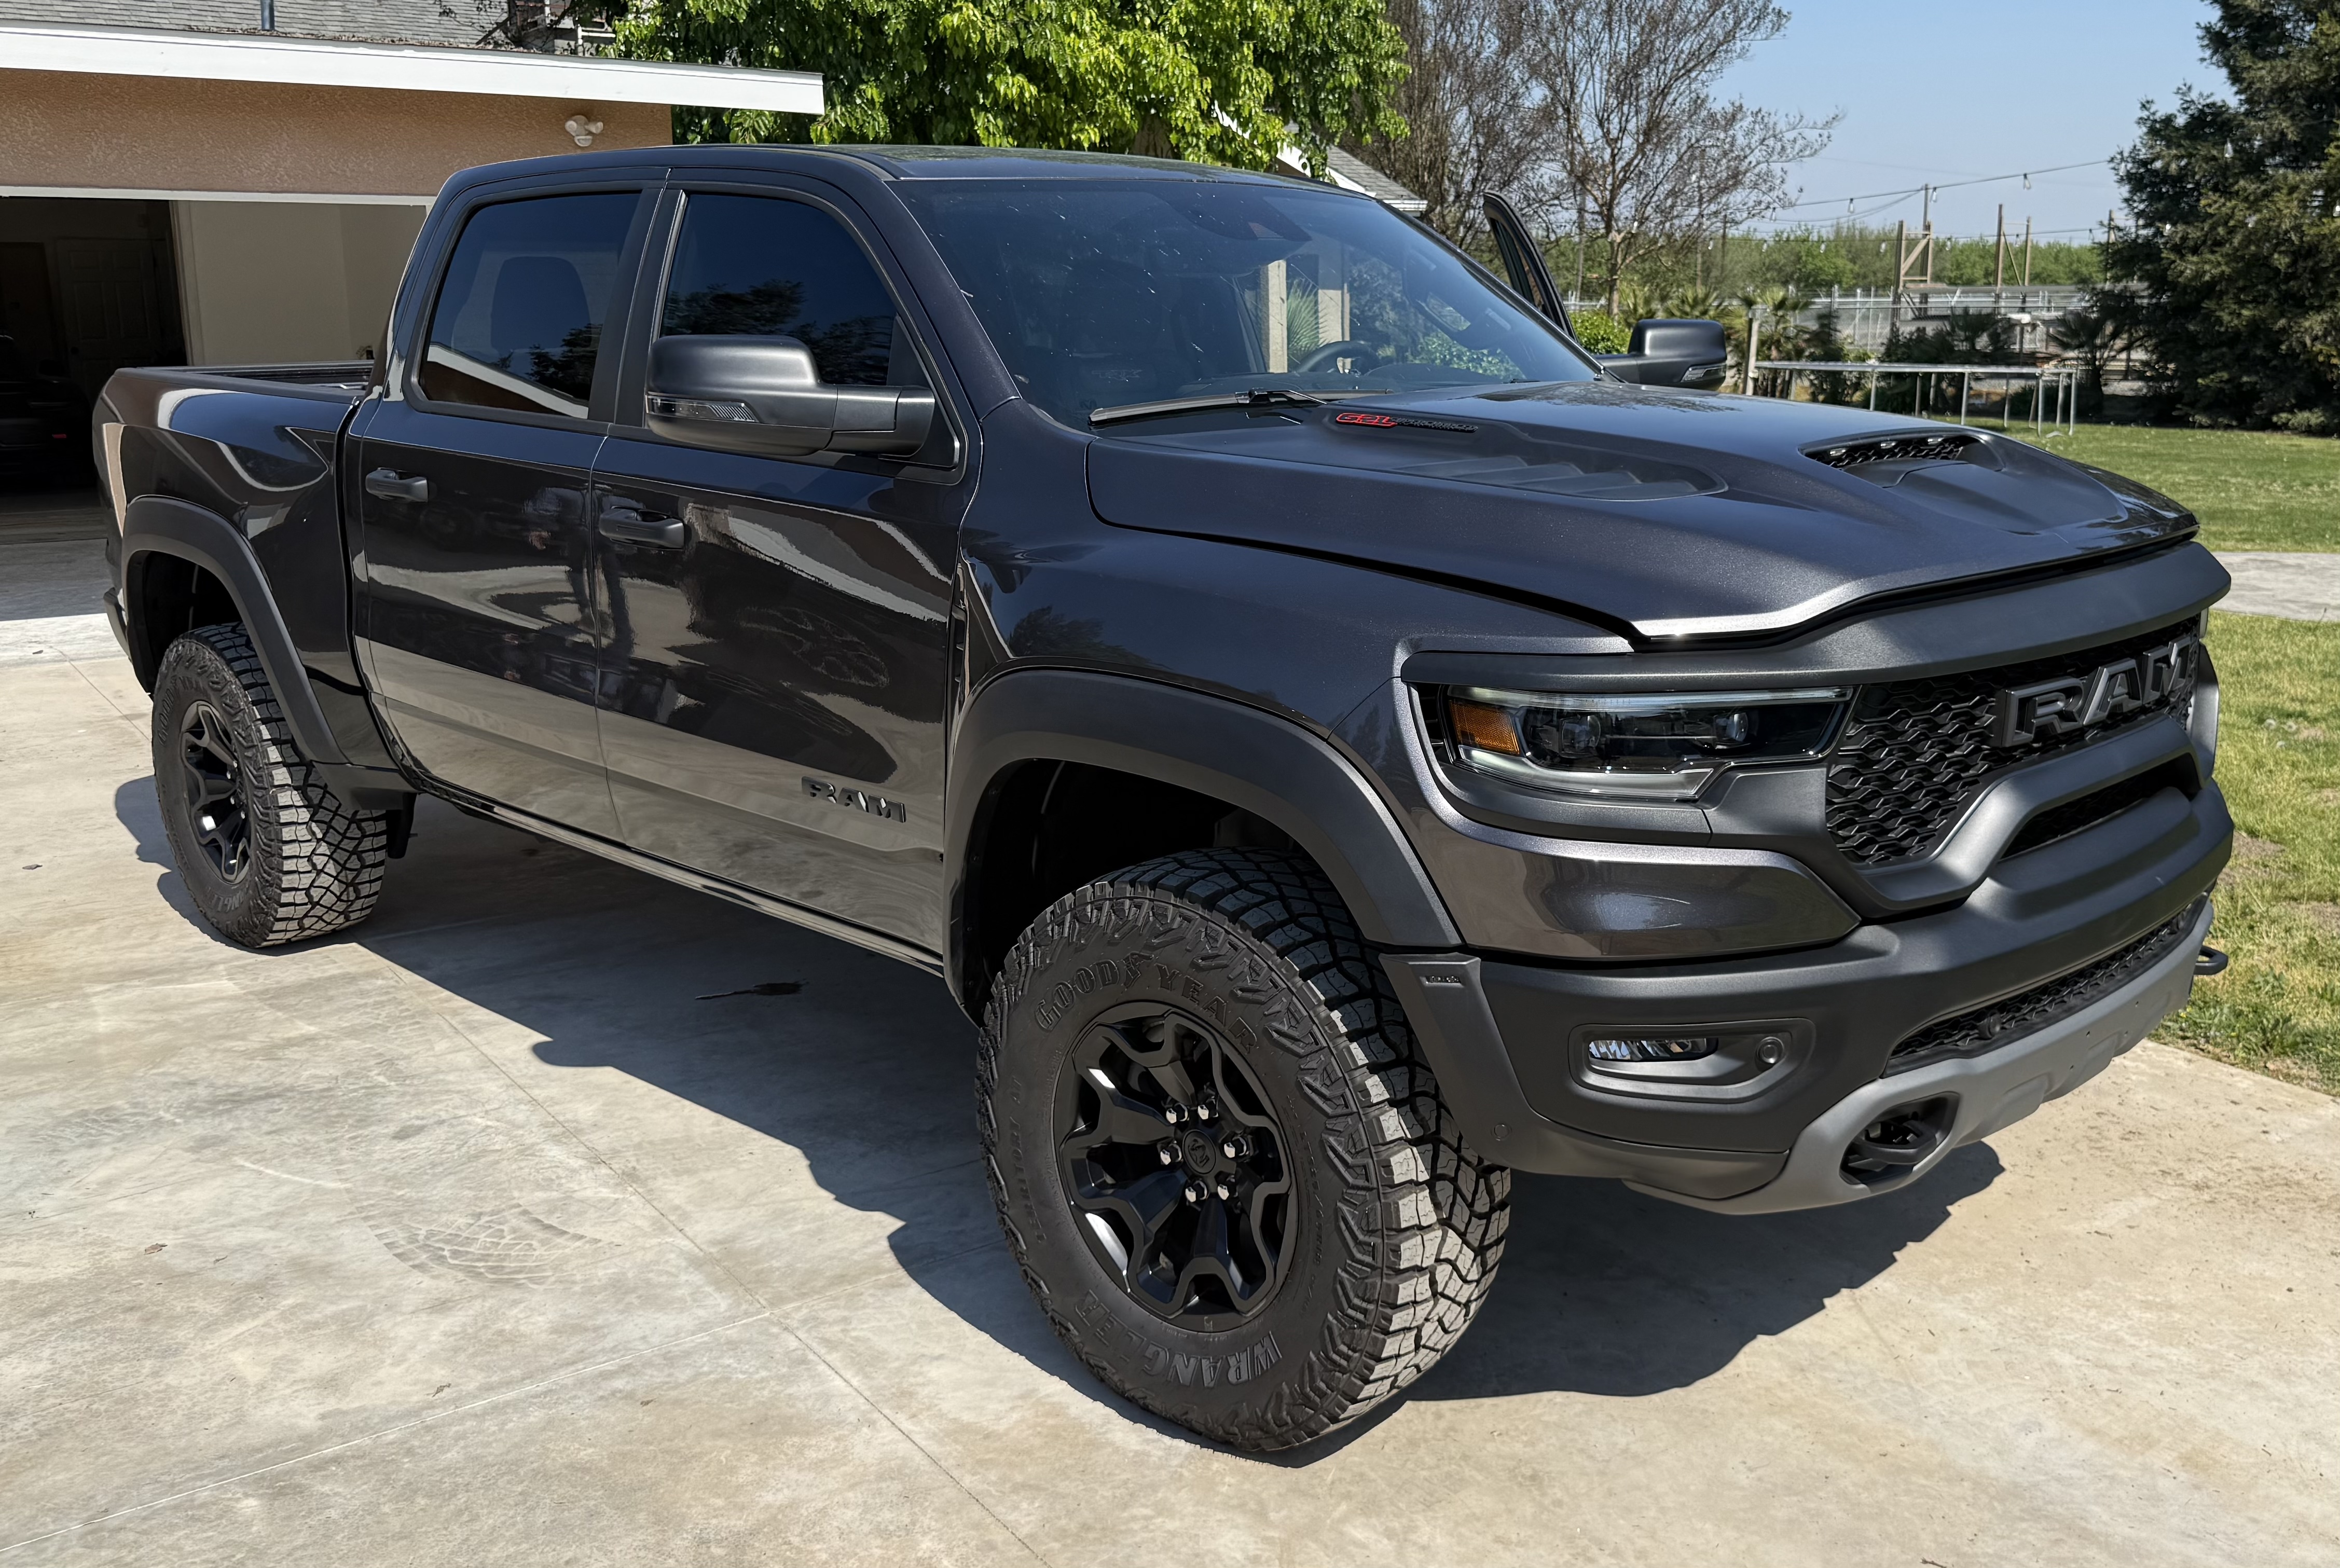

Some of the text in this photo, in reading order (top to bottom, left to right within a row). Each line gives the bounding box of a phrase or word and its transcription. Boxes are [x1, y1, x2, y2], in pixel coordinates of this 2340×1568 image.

[2001, 635, 2191, 747] RAM
[802, 776, 906, 823] RAM
[1035, 951, 1257, 1054] GOODYEAR
[1075, 1289, 1283, 1388] WRANGLER
